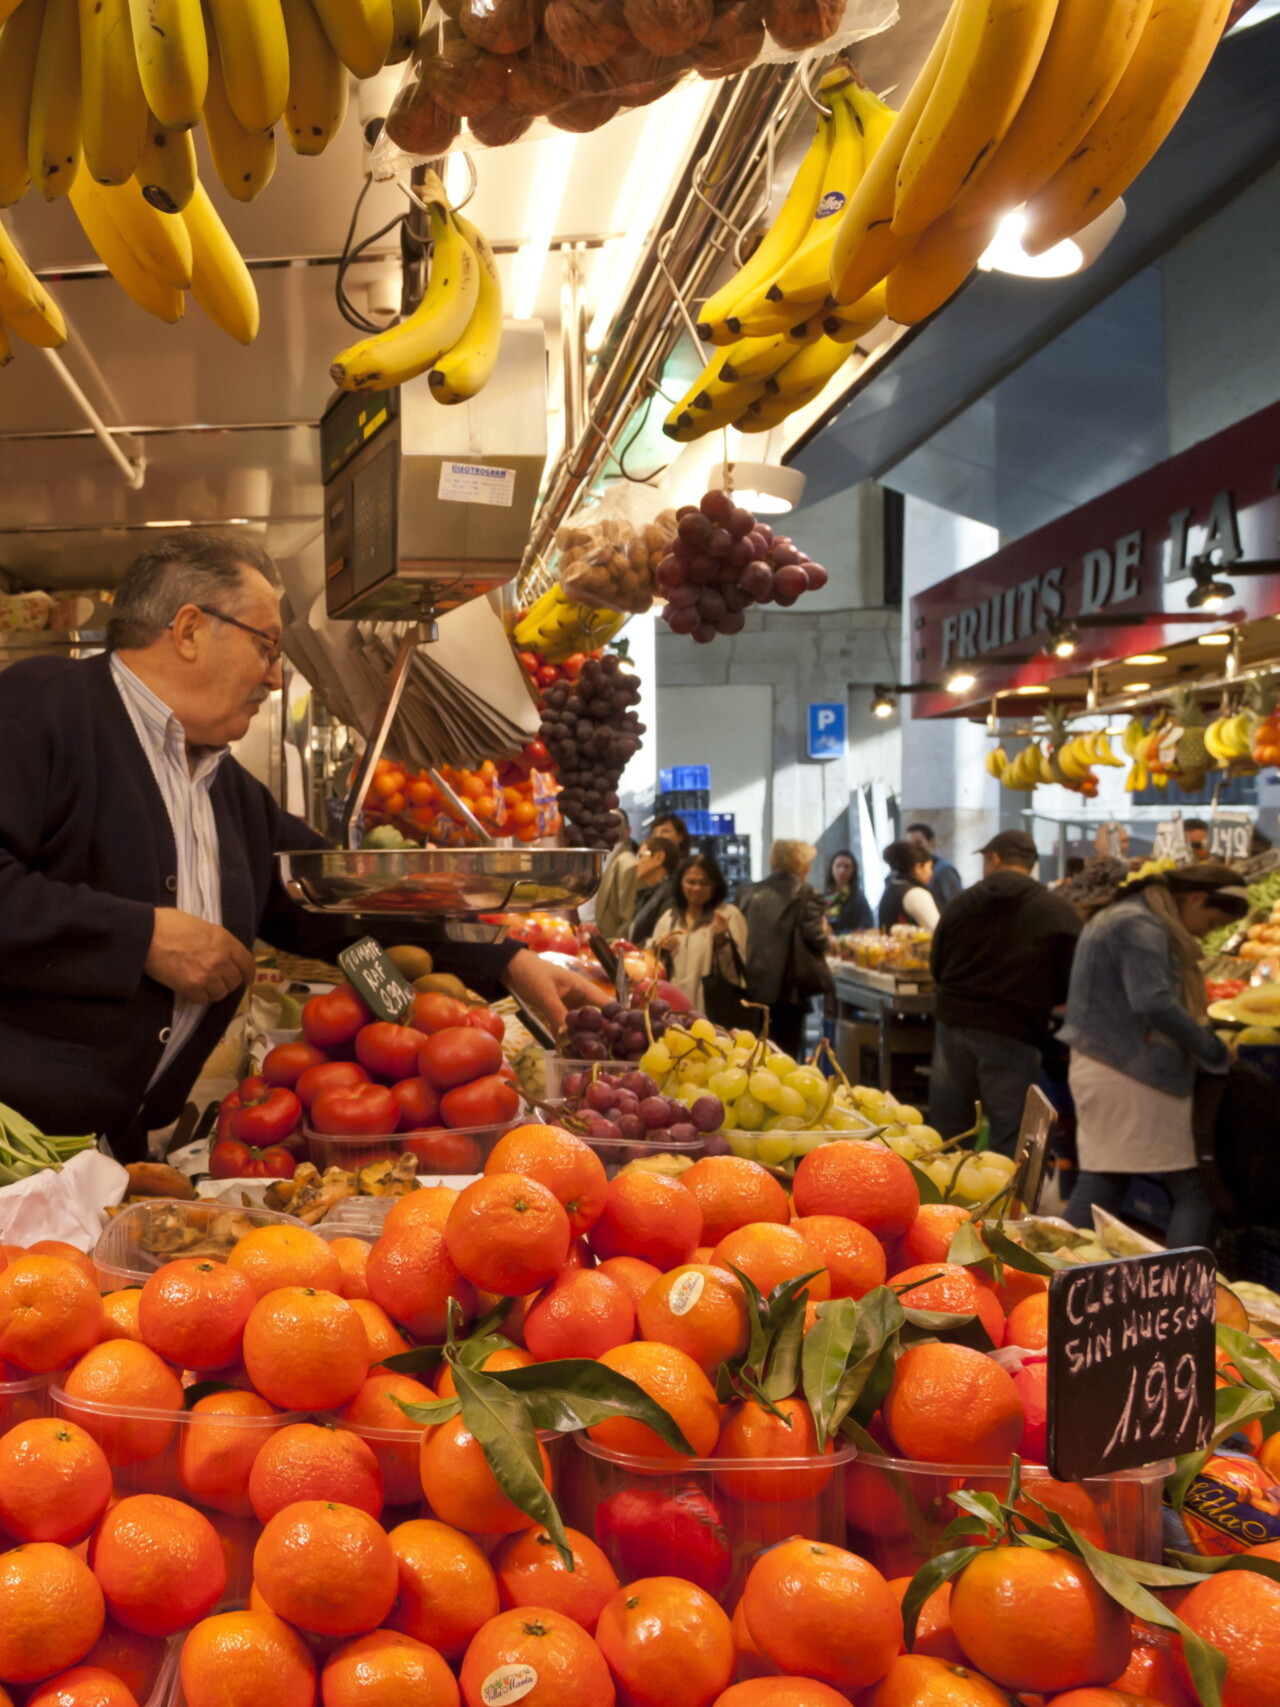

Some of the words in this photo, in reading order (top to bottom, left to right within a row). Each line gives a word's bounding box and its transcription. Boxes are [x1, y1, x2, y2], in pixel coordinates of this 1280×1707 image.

[941, 567, 1066, 668] FRUITS
[1080, 530, 1146, 616] DE
[1166, 490, 1243, 583] LA
[818, 709, 836, 731] P
[345, 941, 382, 972] TOMATE
[362, 960, 386, 993] RAF
[1122, 1305, 1199, 1351] HUESO
[1102, 1353, 1198, 1459] 1.99
